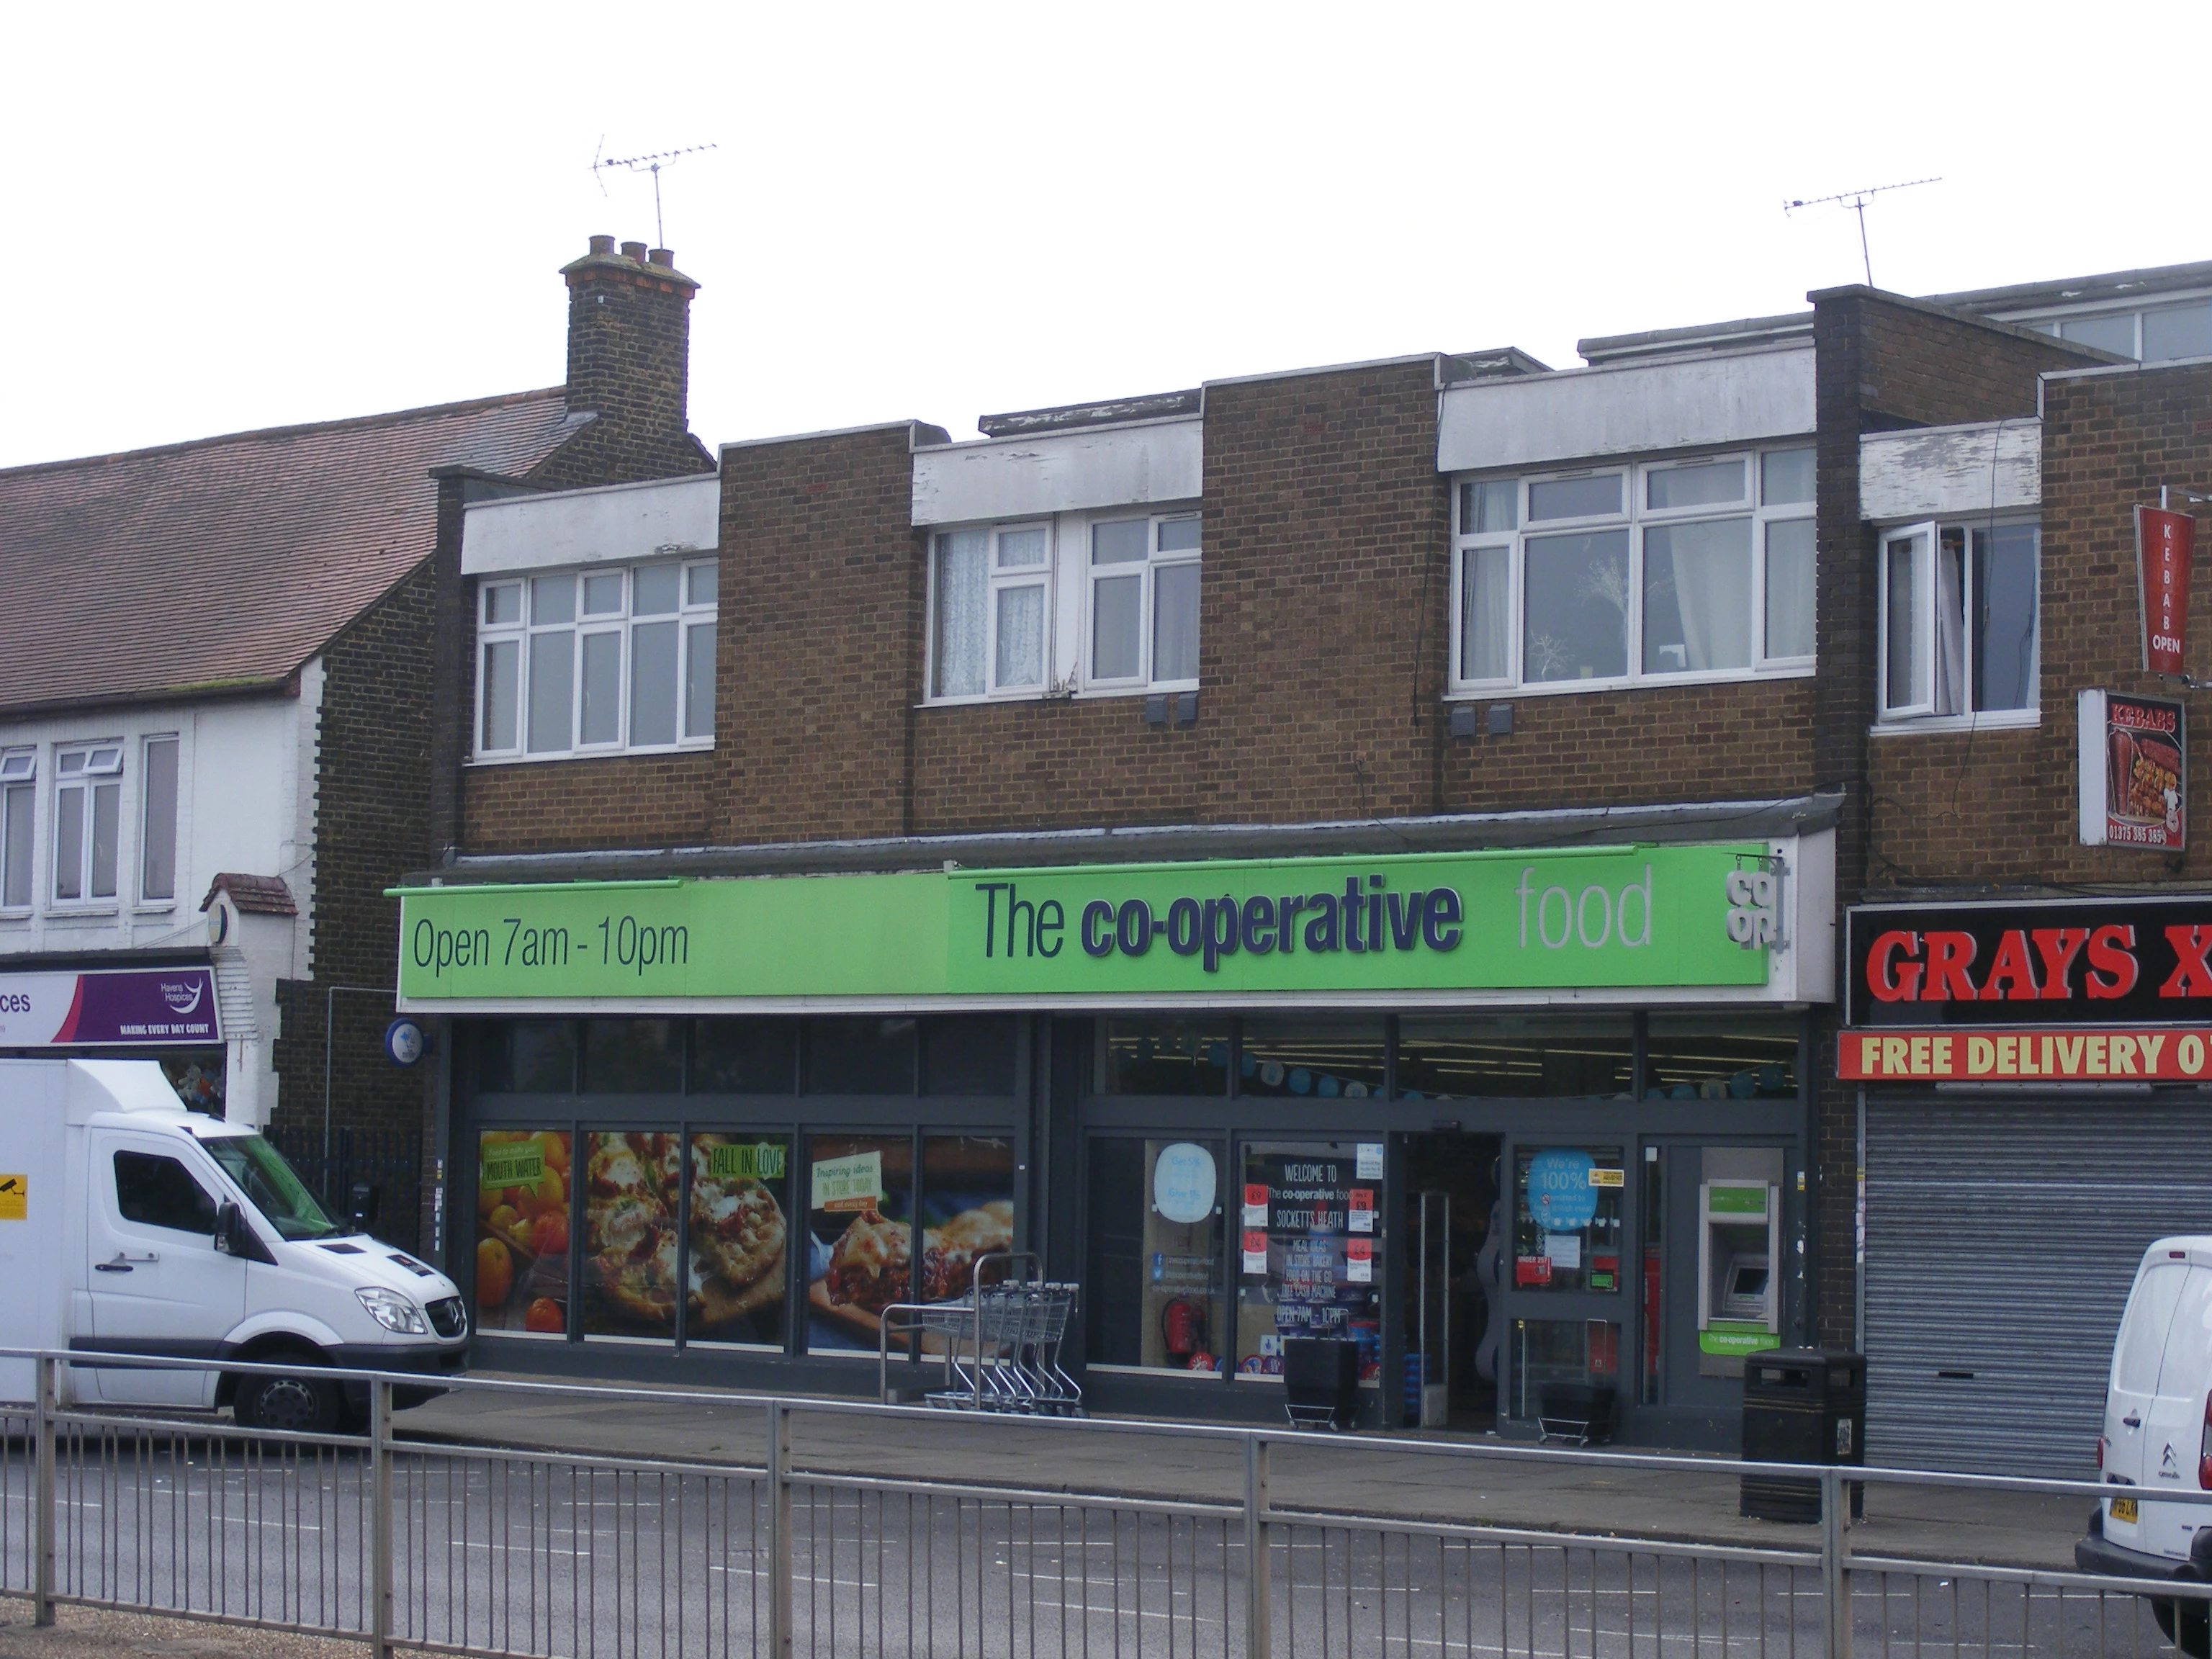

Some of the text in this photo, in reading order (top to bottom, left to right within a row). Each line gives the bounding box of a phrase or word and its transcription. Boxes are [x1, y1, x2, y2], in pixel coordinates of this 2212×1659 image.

[2162, 523, 2172, 631] KEBAB
[2152, 634, 2181, 654] OPEN
[2110, 703, 2176, 733] KEBABS
[2108, 824, 2131, 841] 01375
[975, 863, 1653, 972] The co-operative food
[413, 917, 490, 978] Open
[503, 917, 569, 967] 7am
[598, 914, 688, 977] 10pm
[1866, 924, 2139, 1002] GRAYS
[161, 982, 184, 992] Havens
[165, 992, 194, 1002] Hospices
[120, 1022, 210, 1035] MAKING EVERY DAY COUNT
[1861, 1036, 1953, 1075] FREE
[1966, 1034, 2166, 1075] DELIVERY
[486, 1156, 541, 1181] MOUTH WATER
[712, 1148, 783, 1175] FALL IN LOVE
[1547, 1157, 1580, 1170] We're
[816, 1163, 874, 1179] Inspiring ideas
[1285, 1164, 1337, 1183] WELCOME TO
[1541, 1171, 1587, 1190] 100%
[1268, 1187, 1282, 1200] The
[1282, 1187, 1334, 1202] co-operative
[1276, 1209, 1316, 1228] SOCKETTS
[1317, 1210, 1344, 1229] HEATH
[1292, 1239, 1308, 1253] MEAL
[1312, 1254, 1334, 1268] BAKERY
[1311, 1269, 1323, 1283] THE
[1323, 1269, 1332, 1283] GO
[1311, 1285, 1336, 1299] MACHINE
[1276, 1305, 1295, 1323] OPEN
[1297, 1305, 1312, 1323] 7AM
